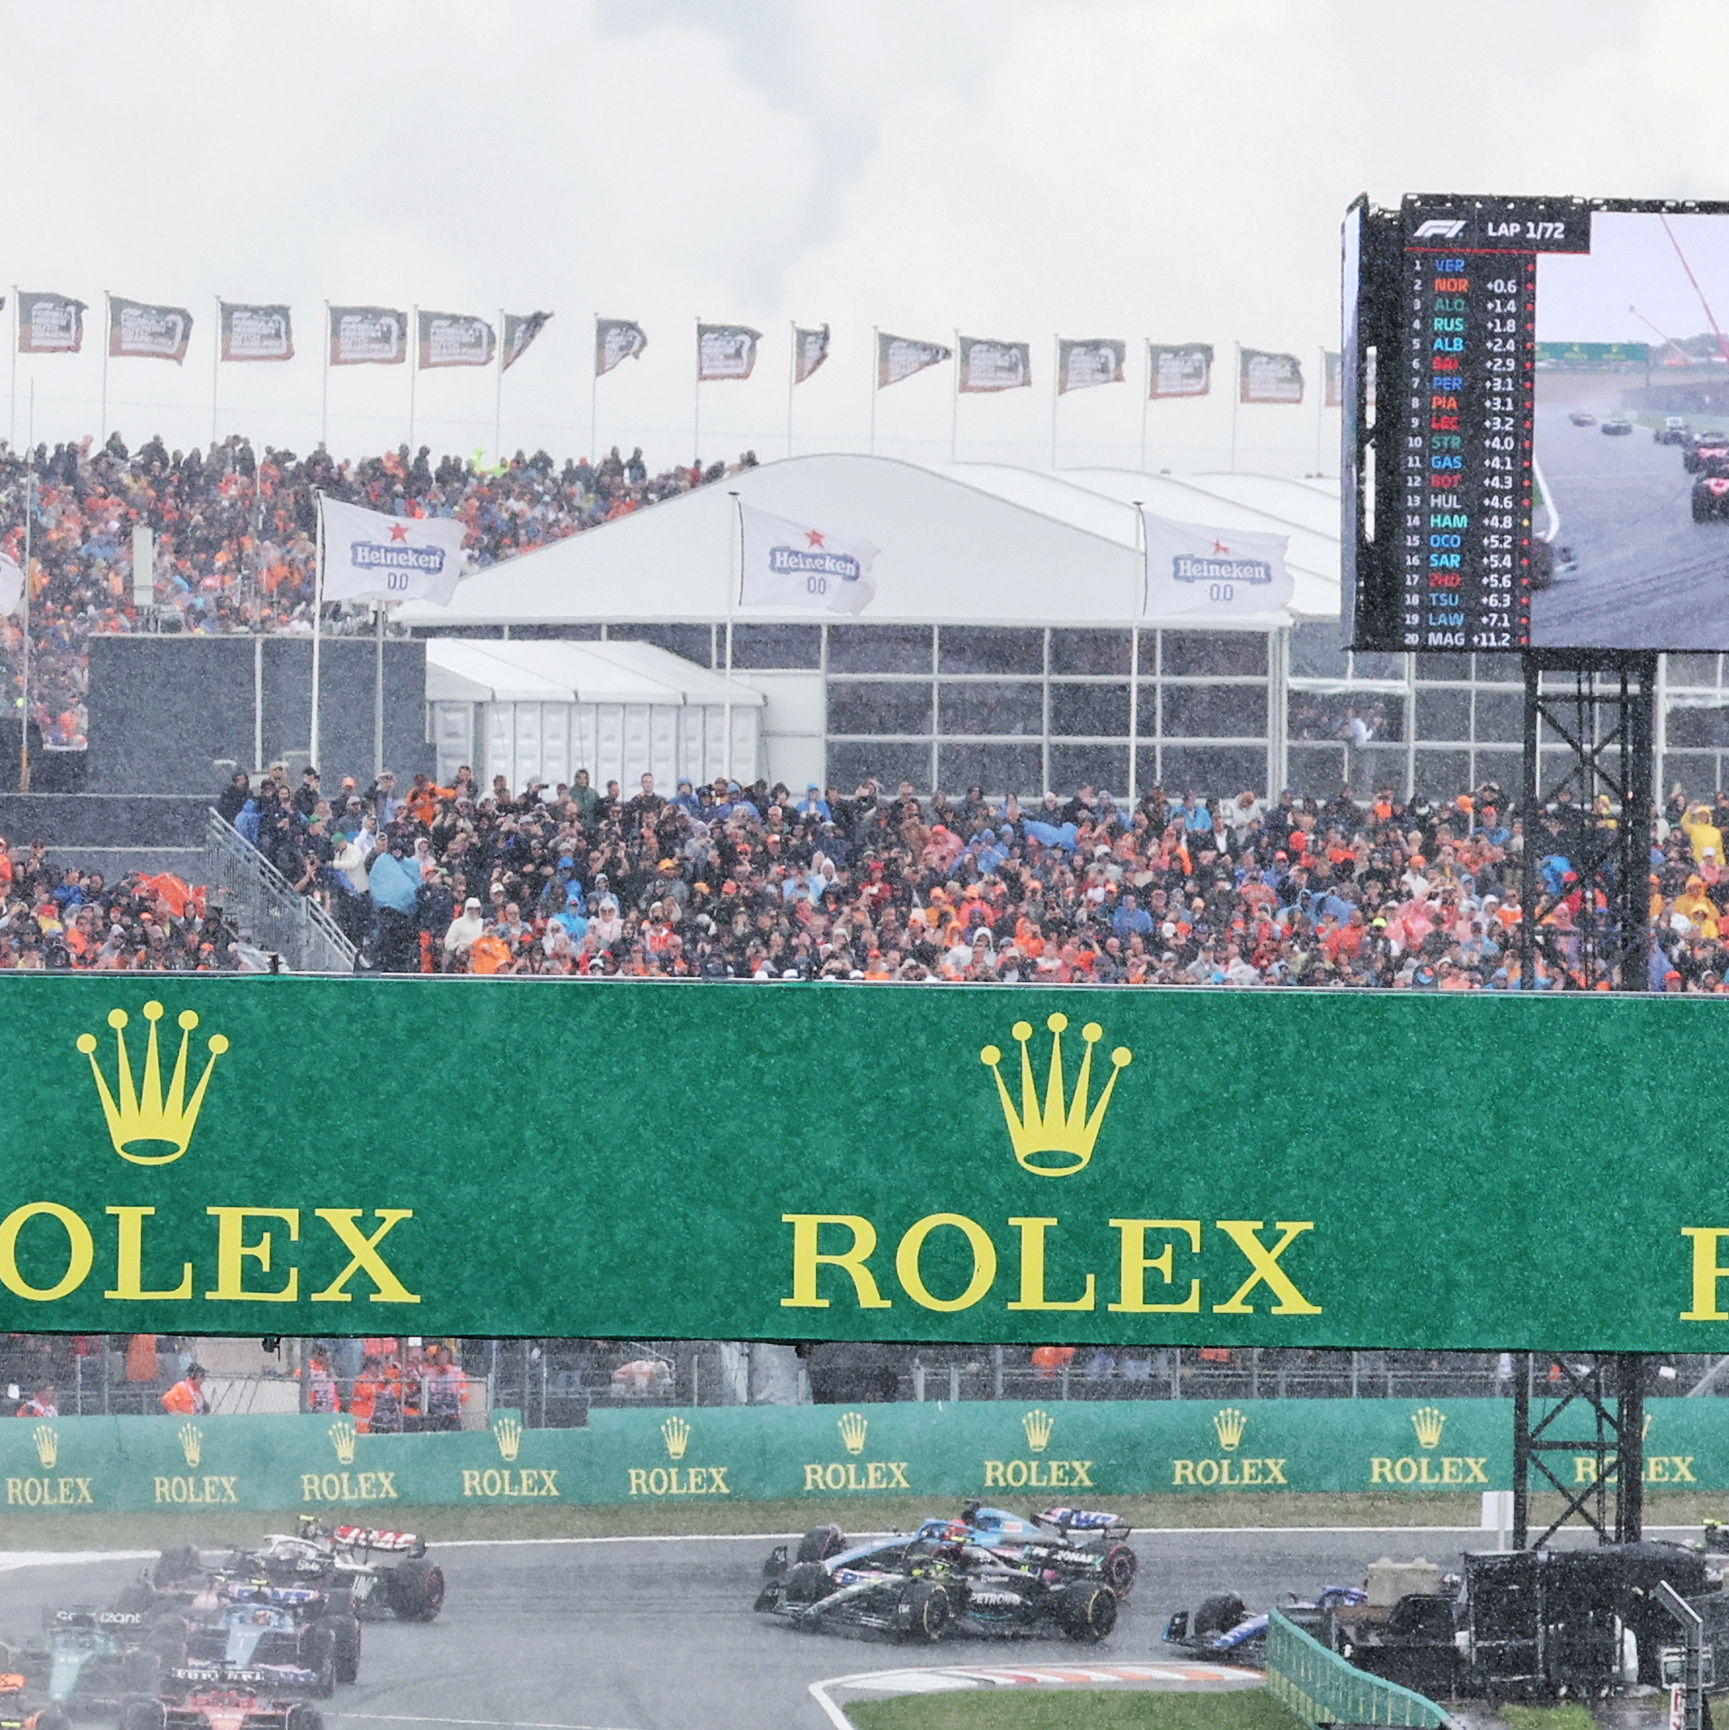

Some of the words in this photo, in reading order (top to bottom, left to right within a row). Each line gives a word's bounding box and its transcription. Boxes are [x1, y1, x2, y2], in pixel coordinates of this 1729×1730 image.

[1487, 222, 1521, 237] LAP
[1526, 222, 1564, 239] 1/72
[1414, 260, 1421, 271] 1
[1435, 259, 1465, 272] VER
[1413, 280, 1422, 291] 2
[1434, 279, 1469, 292] NOR
[1487, 280, 1517, 293] +0.6
[1486, 300, 1517, 312] +1.4
[1413, 319, 1421, 330] 4
[1434, 318, 1465, 331] RUS
[1486, 319, 1516, 332] +1.8
[1412, 339, 1421, 350] 5
[1433, 338, 1464, 351] ALB
[1486, 339, 1516, 352] +2.4
[1412, 358, 1420, 369] 6
[1486, 359, 1516, 371] +2.9
[1412, 378, 1420, 389] 7
[1432, 377, 1463, 390] PER
[1485, 378, 1514, 391] +3.1
[1411, 398, 1420, 409] 8
[1432, 397, 1459, 410] PIA
[1484, 398, 1514, 411] +3.1
[1411, 417, 1420, 428] 9
[1484, 418, 1514, 430] +3.2
[1408, 437, 1422, 448] 10
[1431, 436, 1462, 449] STR
[1484, 437, 1515, 450] +4.0
[1407, 457, 1422, 468] 11
[1431, 456, 1463, 469] GAS
[1483, 457, 1513, 470] +4.1
[1407, 476, 1421, 487] 12
[1483, 477, 1513, 489] +4.3
[1407, 496, 1421, 507] 13
[1430, 495, 1462, 508] HUL
[1483, 496, 1513, 509] +4.6
[1406, 516, 1421, 527] 14
[1430, 515, 1468, 528] HAM
[1483, 516, 1513, 529] +4.8
[1406, 535, 1420, 546] 15
[1482, 536, 1513, 548] +5.2
[357, 545, 441, 569] Heineken
[775, 551, 857, 576] Heineken
[1406, 555, 1420, 566] 16
[1429, 554, 1460, 567] SAR
[1482, 555, 1512, 568] +5.4
[1179, 559, 1265, 578] Heineken
[387, 572, 408, 590] 0.0
[1405, 575, 1419, 586] 17
[1482, 575, 1512, 588] +5.6
[1405, 594, 1420, 605] 18
[1429, 594, 1459, 606] TSU
[1482, 595, 1511, 607] +6.3
[1405, 614, 1419, 625] 19
[1428, 613, 1465, 626] LAW
[1481, 614, 1510, 627] +7.1
[1404, 634, 1419, 645] 20
[1428, 633, 1465, 646] MAG
[1472, 634, 1510, 647] +11.2
[781, 1213, 1321, 1314] ROLEX
[806, 1462, 908, 1490] ROLEX
[986, 1460, 1092, 1488] ROLEX
[1173, 1458, 1287, 1486] ROLEX
[1371, 1457, 1488, 1484] ROLEX
[300, 1472, 398, 1502] ROLEX
[462, 1468, 560, 1498] ROLEX
[629, 1467, 730, 1495] ROLEX
[5, 1477, 93, 1506] ROLEX
[153, 1475, 239, 1504] ROLEX
